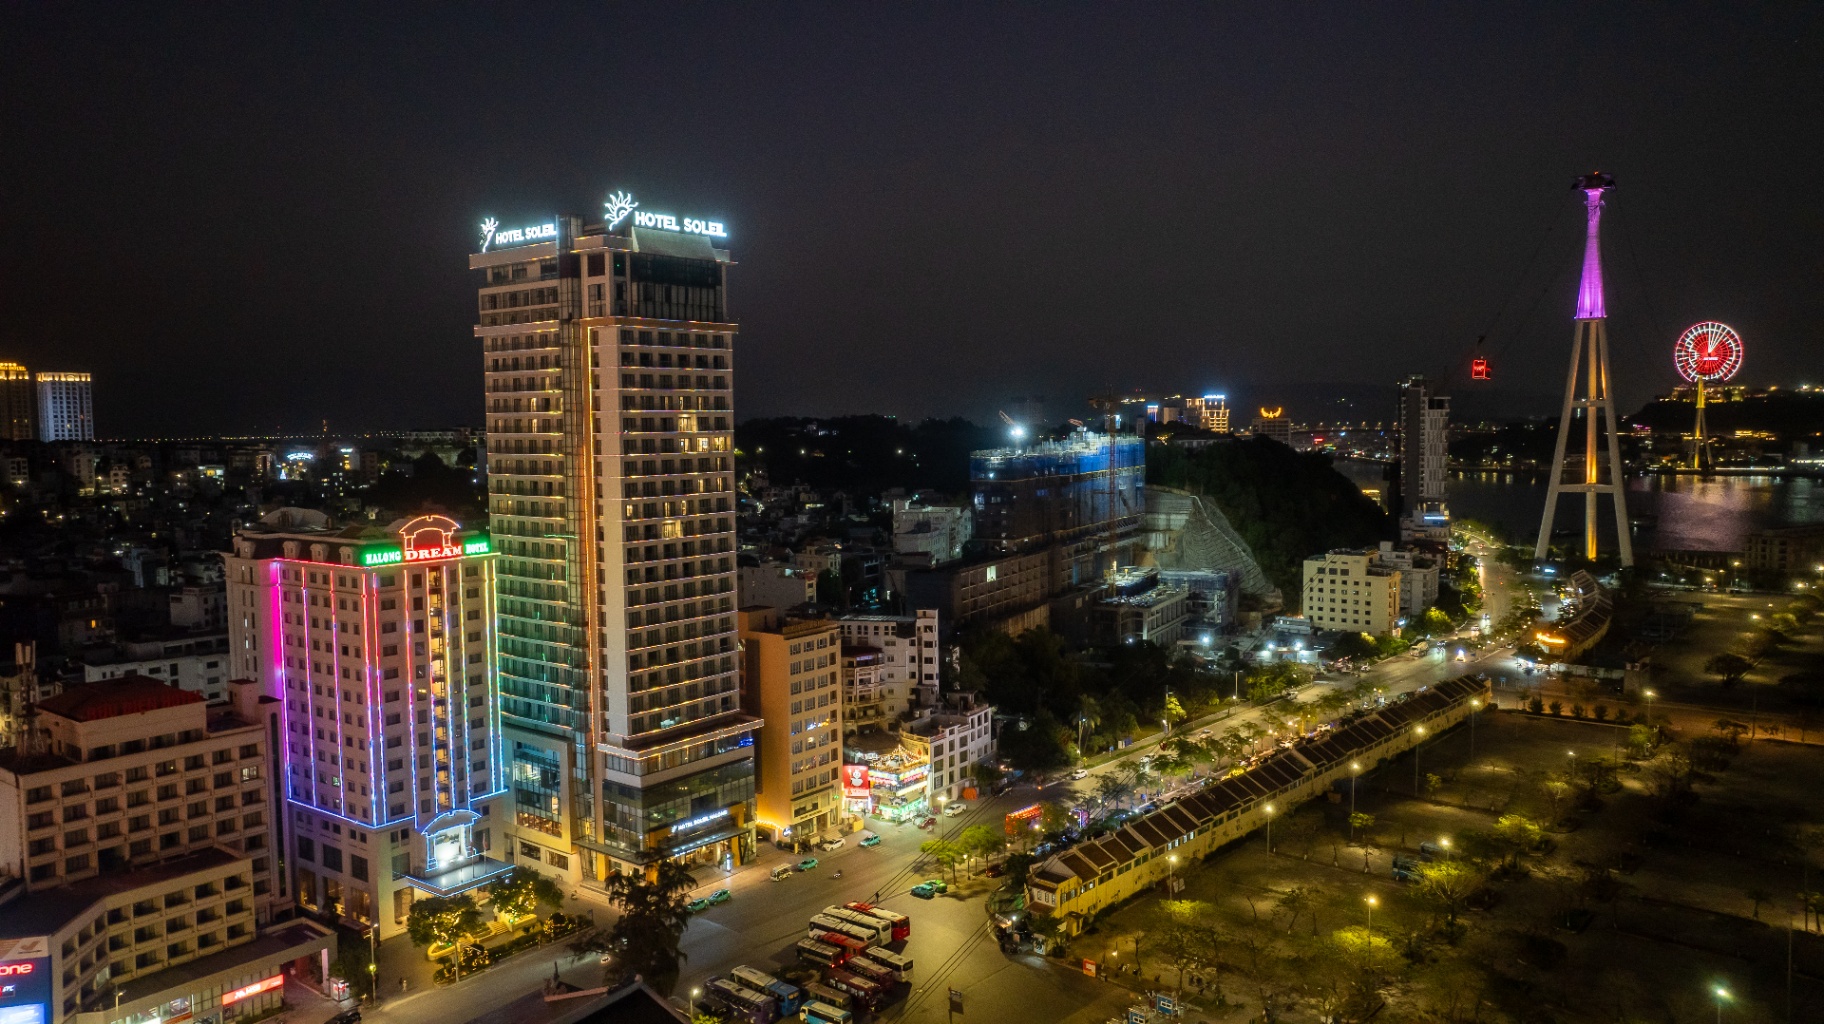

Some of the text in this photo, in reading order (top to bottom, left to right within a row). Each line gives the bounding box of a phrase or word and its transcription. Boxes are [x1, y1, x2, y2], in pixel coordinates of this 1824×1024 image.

[495, 223, 557, 244] HOTEL SOLEIL
[634, 211, 728, 237] HOTEL SOLEIL
[365, 542, 489, 564] HALONG DREAM HOTEL
